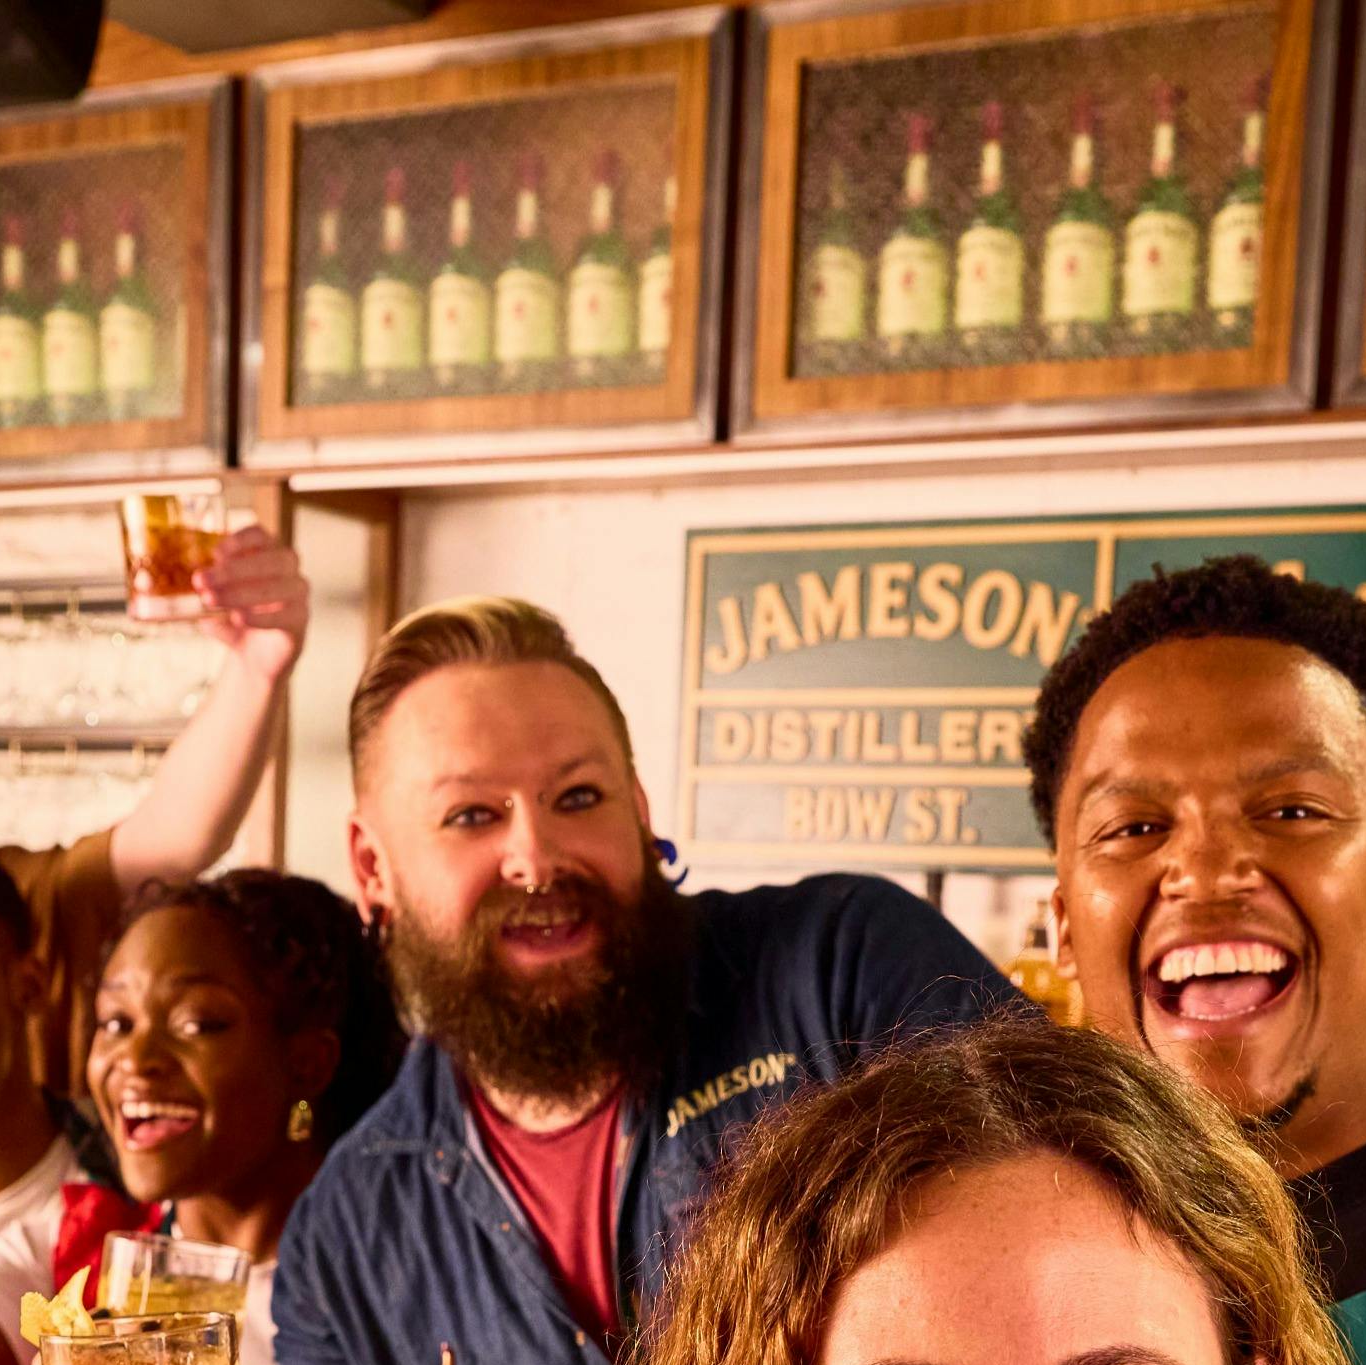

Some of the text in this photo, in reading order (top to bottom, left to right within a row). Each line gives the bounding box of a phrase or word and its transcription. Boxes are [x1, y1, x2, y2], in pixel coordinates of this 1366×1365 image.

[713, 708, 1036, 764] DISTILLER
[783, 786, 979, 845] BOW ST.
